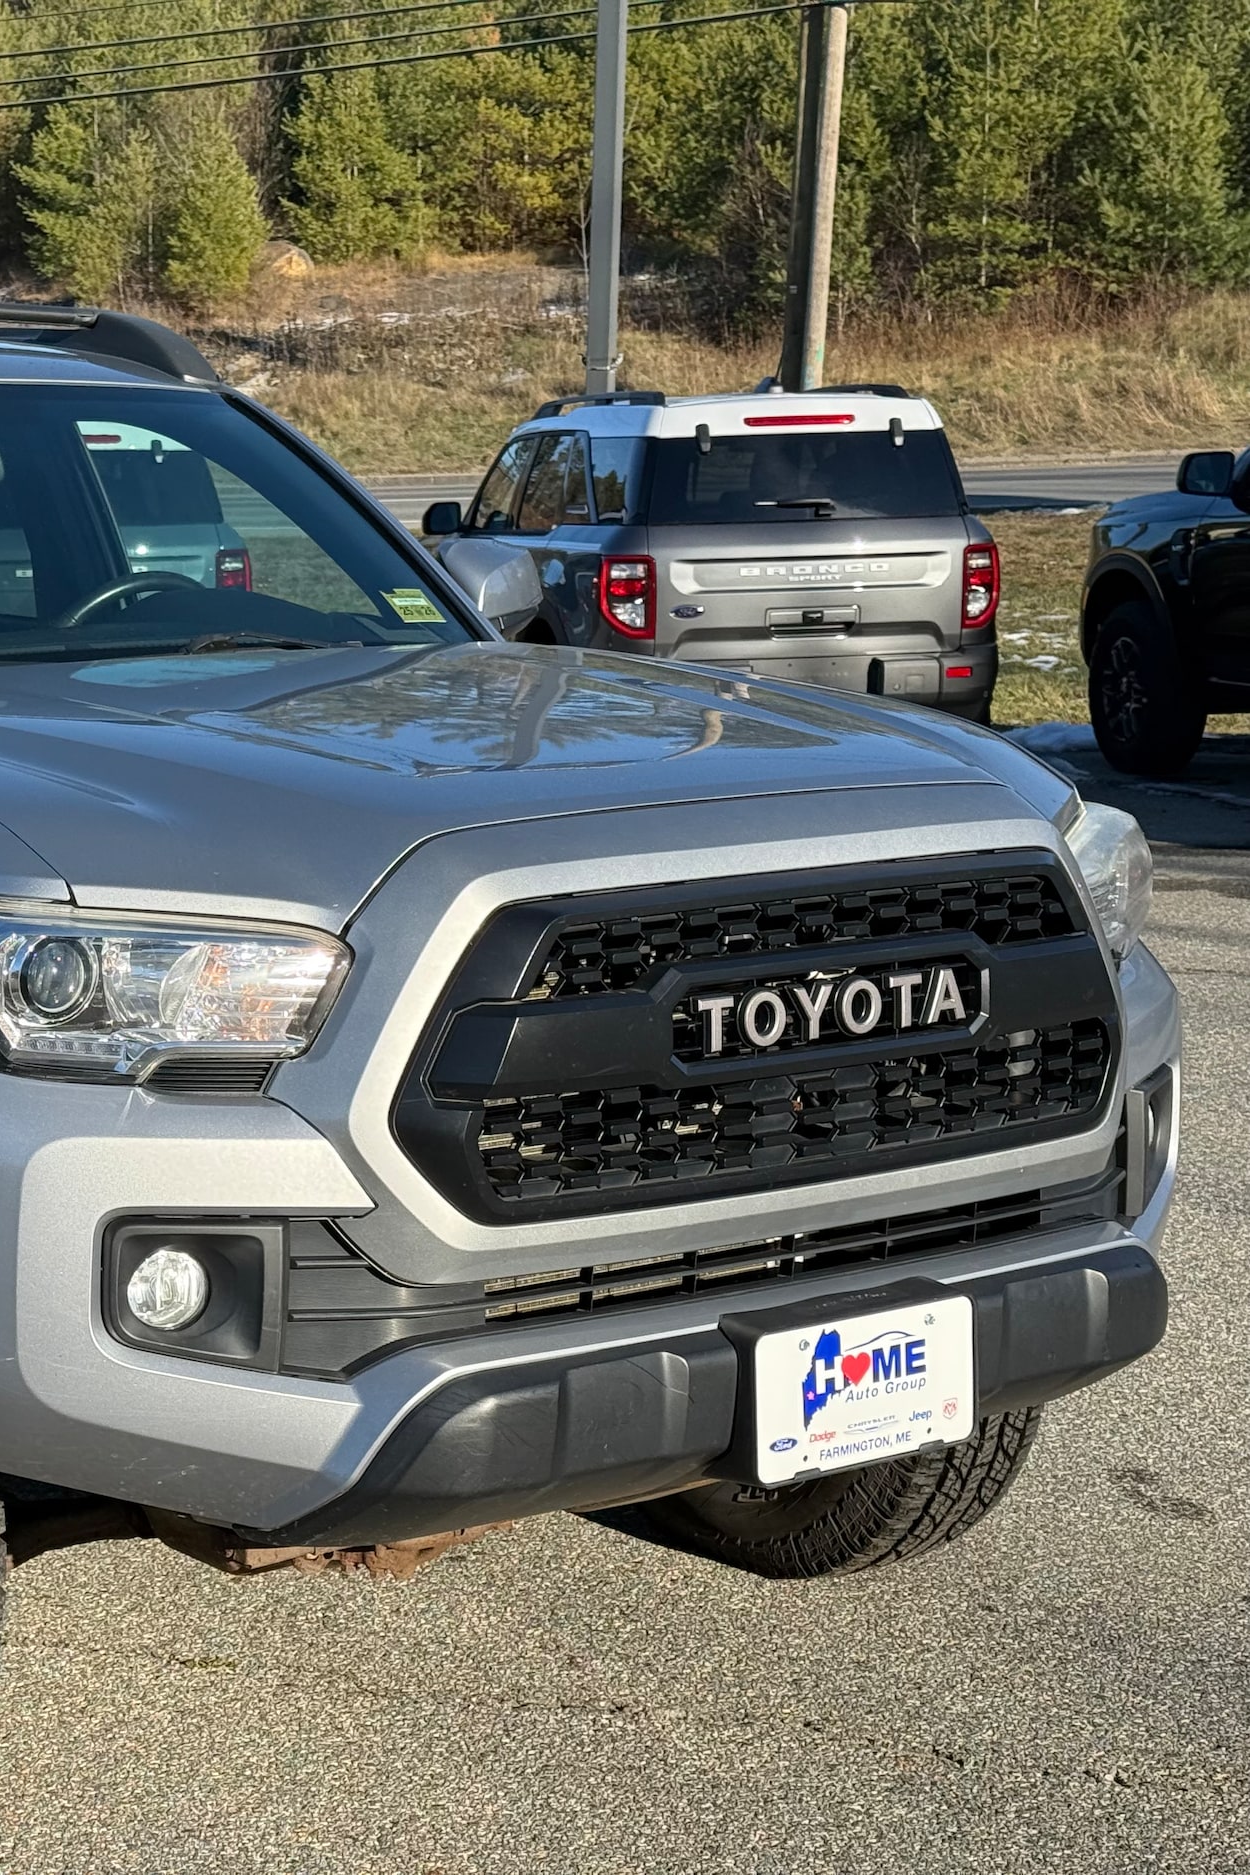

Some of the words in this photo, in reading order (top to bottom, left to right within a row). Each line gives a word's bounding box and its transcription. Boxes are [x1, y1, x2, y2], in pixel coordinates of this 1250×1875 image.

[739, 562, 890, 577] BRONCO
[788, 573, 843, 582] SPORT
[694, 967, 966, 1056] TOYOTA
[845, 1386, 879, 1403] Auto
[885, 1377, 926, 1394] Group
[847, 1415, 896, 1429] CHRYSLER
[908, 1410, 933, 1422] Jeep
[809, 1430, 837, 1443] Dodge
[819, 1434, 893, 1461] FARMINGTON,
[895, 1430, 912, 1445] ME
